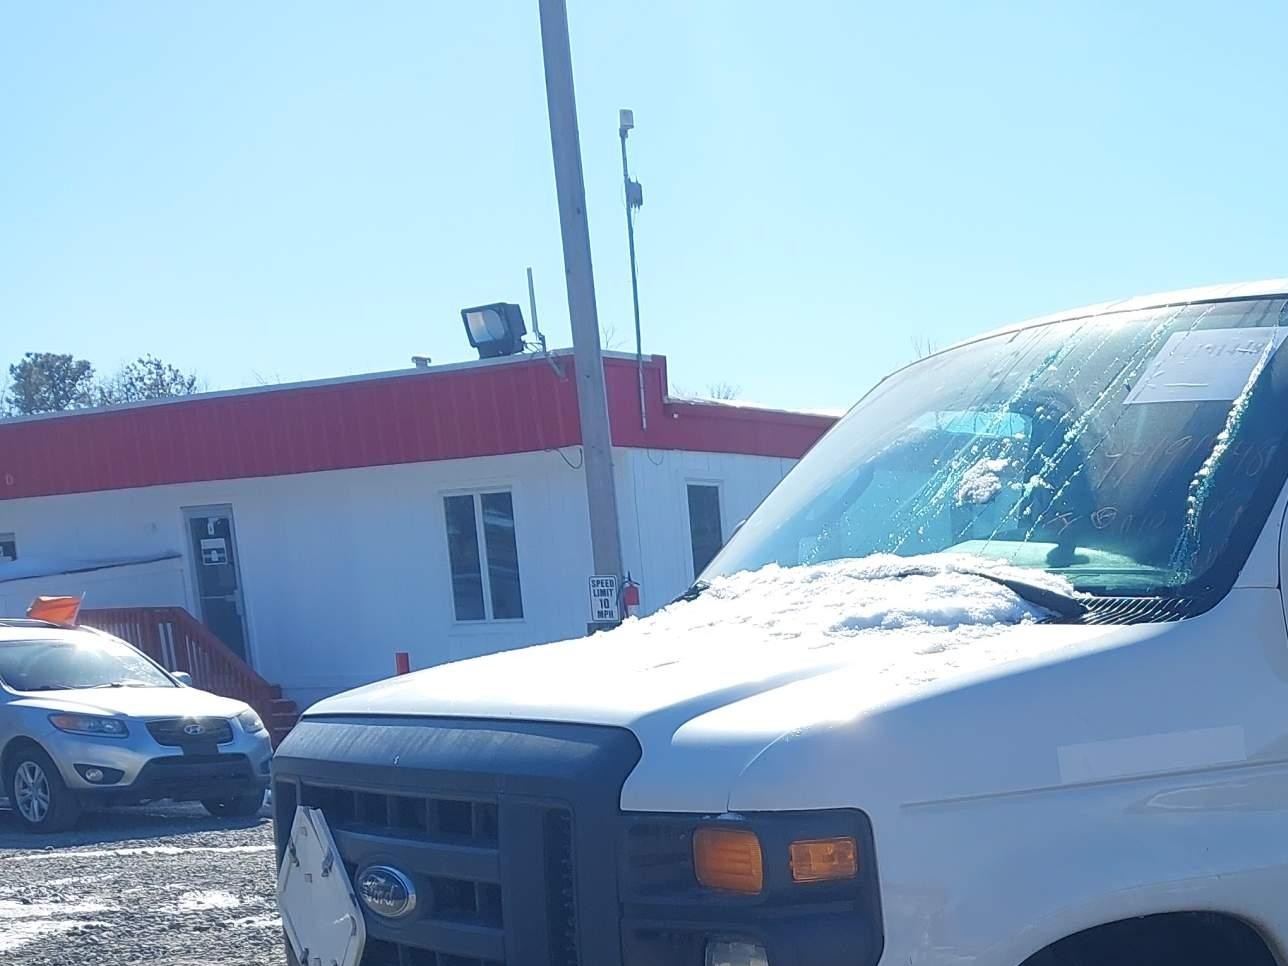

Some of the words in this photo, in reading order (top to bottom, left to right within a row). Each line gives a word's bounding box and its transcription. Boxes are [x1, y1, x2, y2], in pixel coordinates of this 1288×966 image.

[591, 579, 614, 588] SPEED
[593, 588, 614, 597] LIMIT
[599, 598, 610, 609] 10
[597, 610, 614, 619] MPH
[362, 874, 398, 906] Ford
